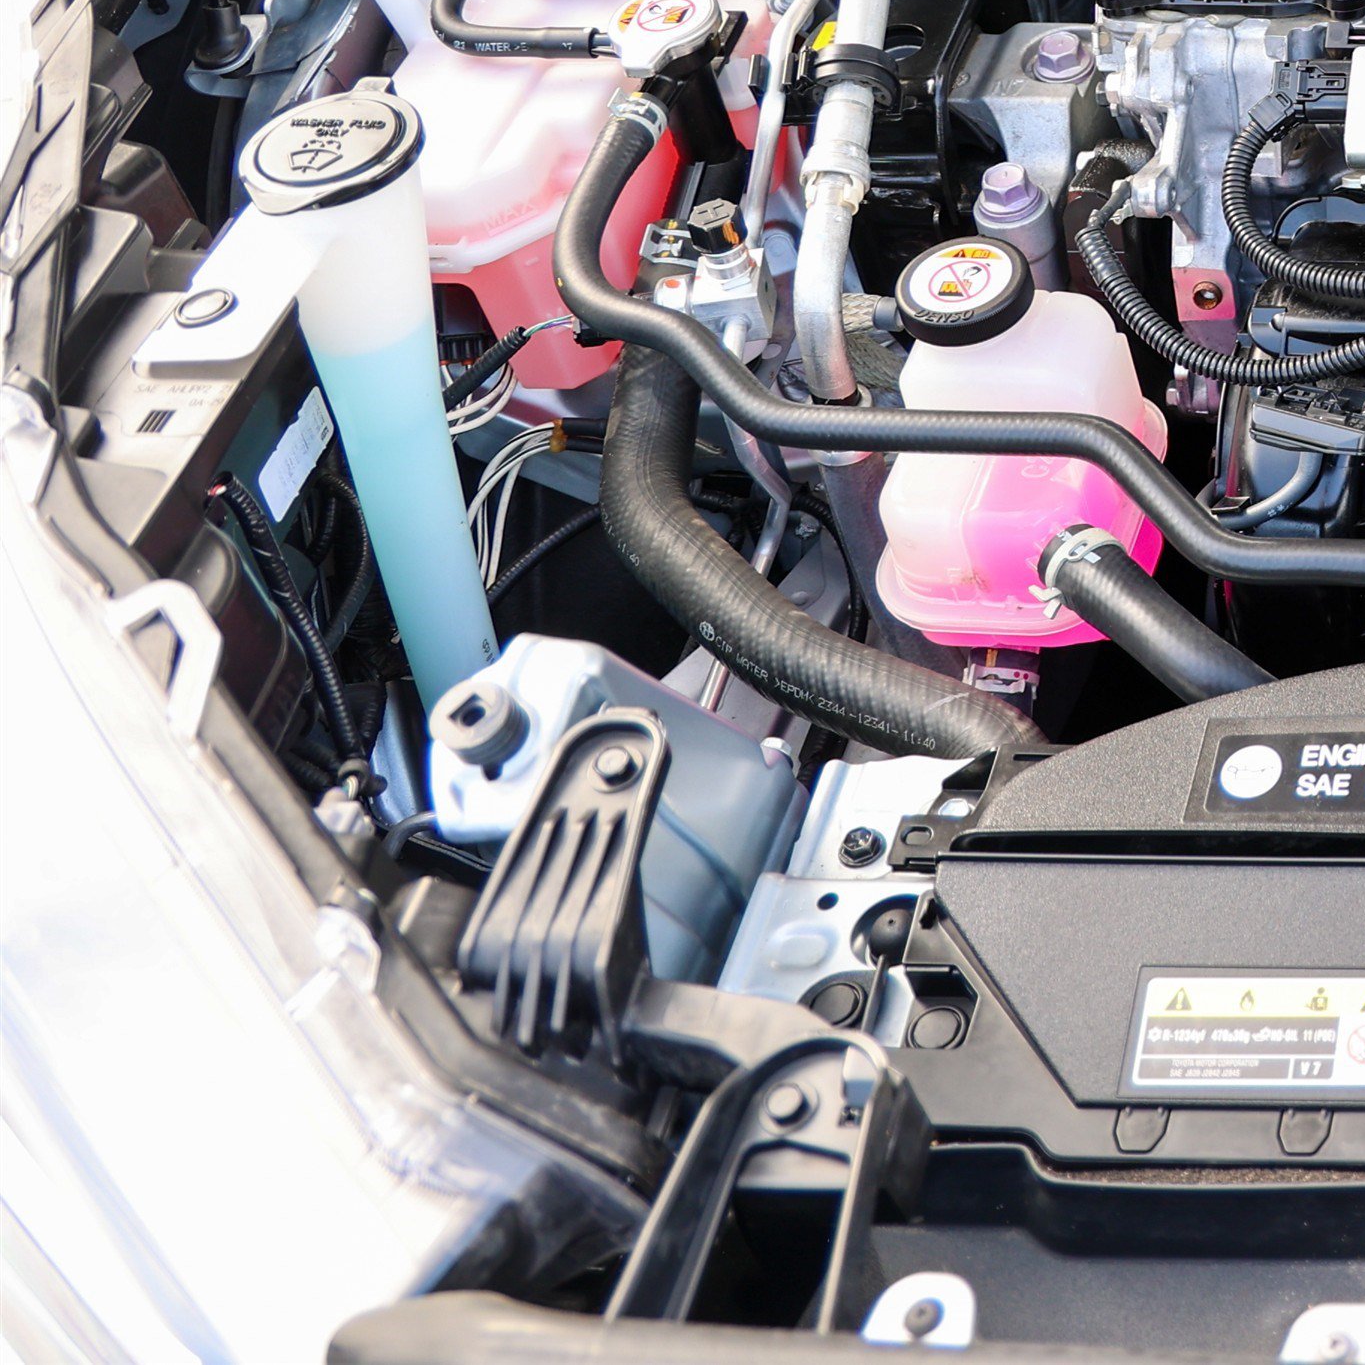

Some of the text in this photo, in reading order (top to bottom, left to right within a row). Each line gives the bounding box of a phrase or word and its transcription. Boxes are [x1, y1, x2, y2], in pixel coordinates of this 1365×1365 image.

[475, 42, 512, 52] WATER
[290, 118, 387, 130] WASHER FLUID
[914, 309, 975, 323] DENSO
[736, 654, 768, 683] WATER
[818, 696, 846, 717] 2344
[1296, 773, 1352, 797] SAE
[1172, 1059, 1260, 1068] TOYOTA MOTOR CORPORATION
[1169, 1069, 1183, 1078] SAE
